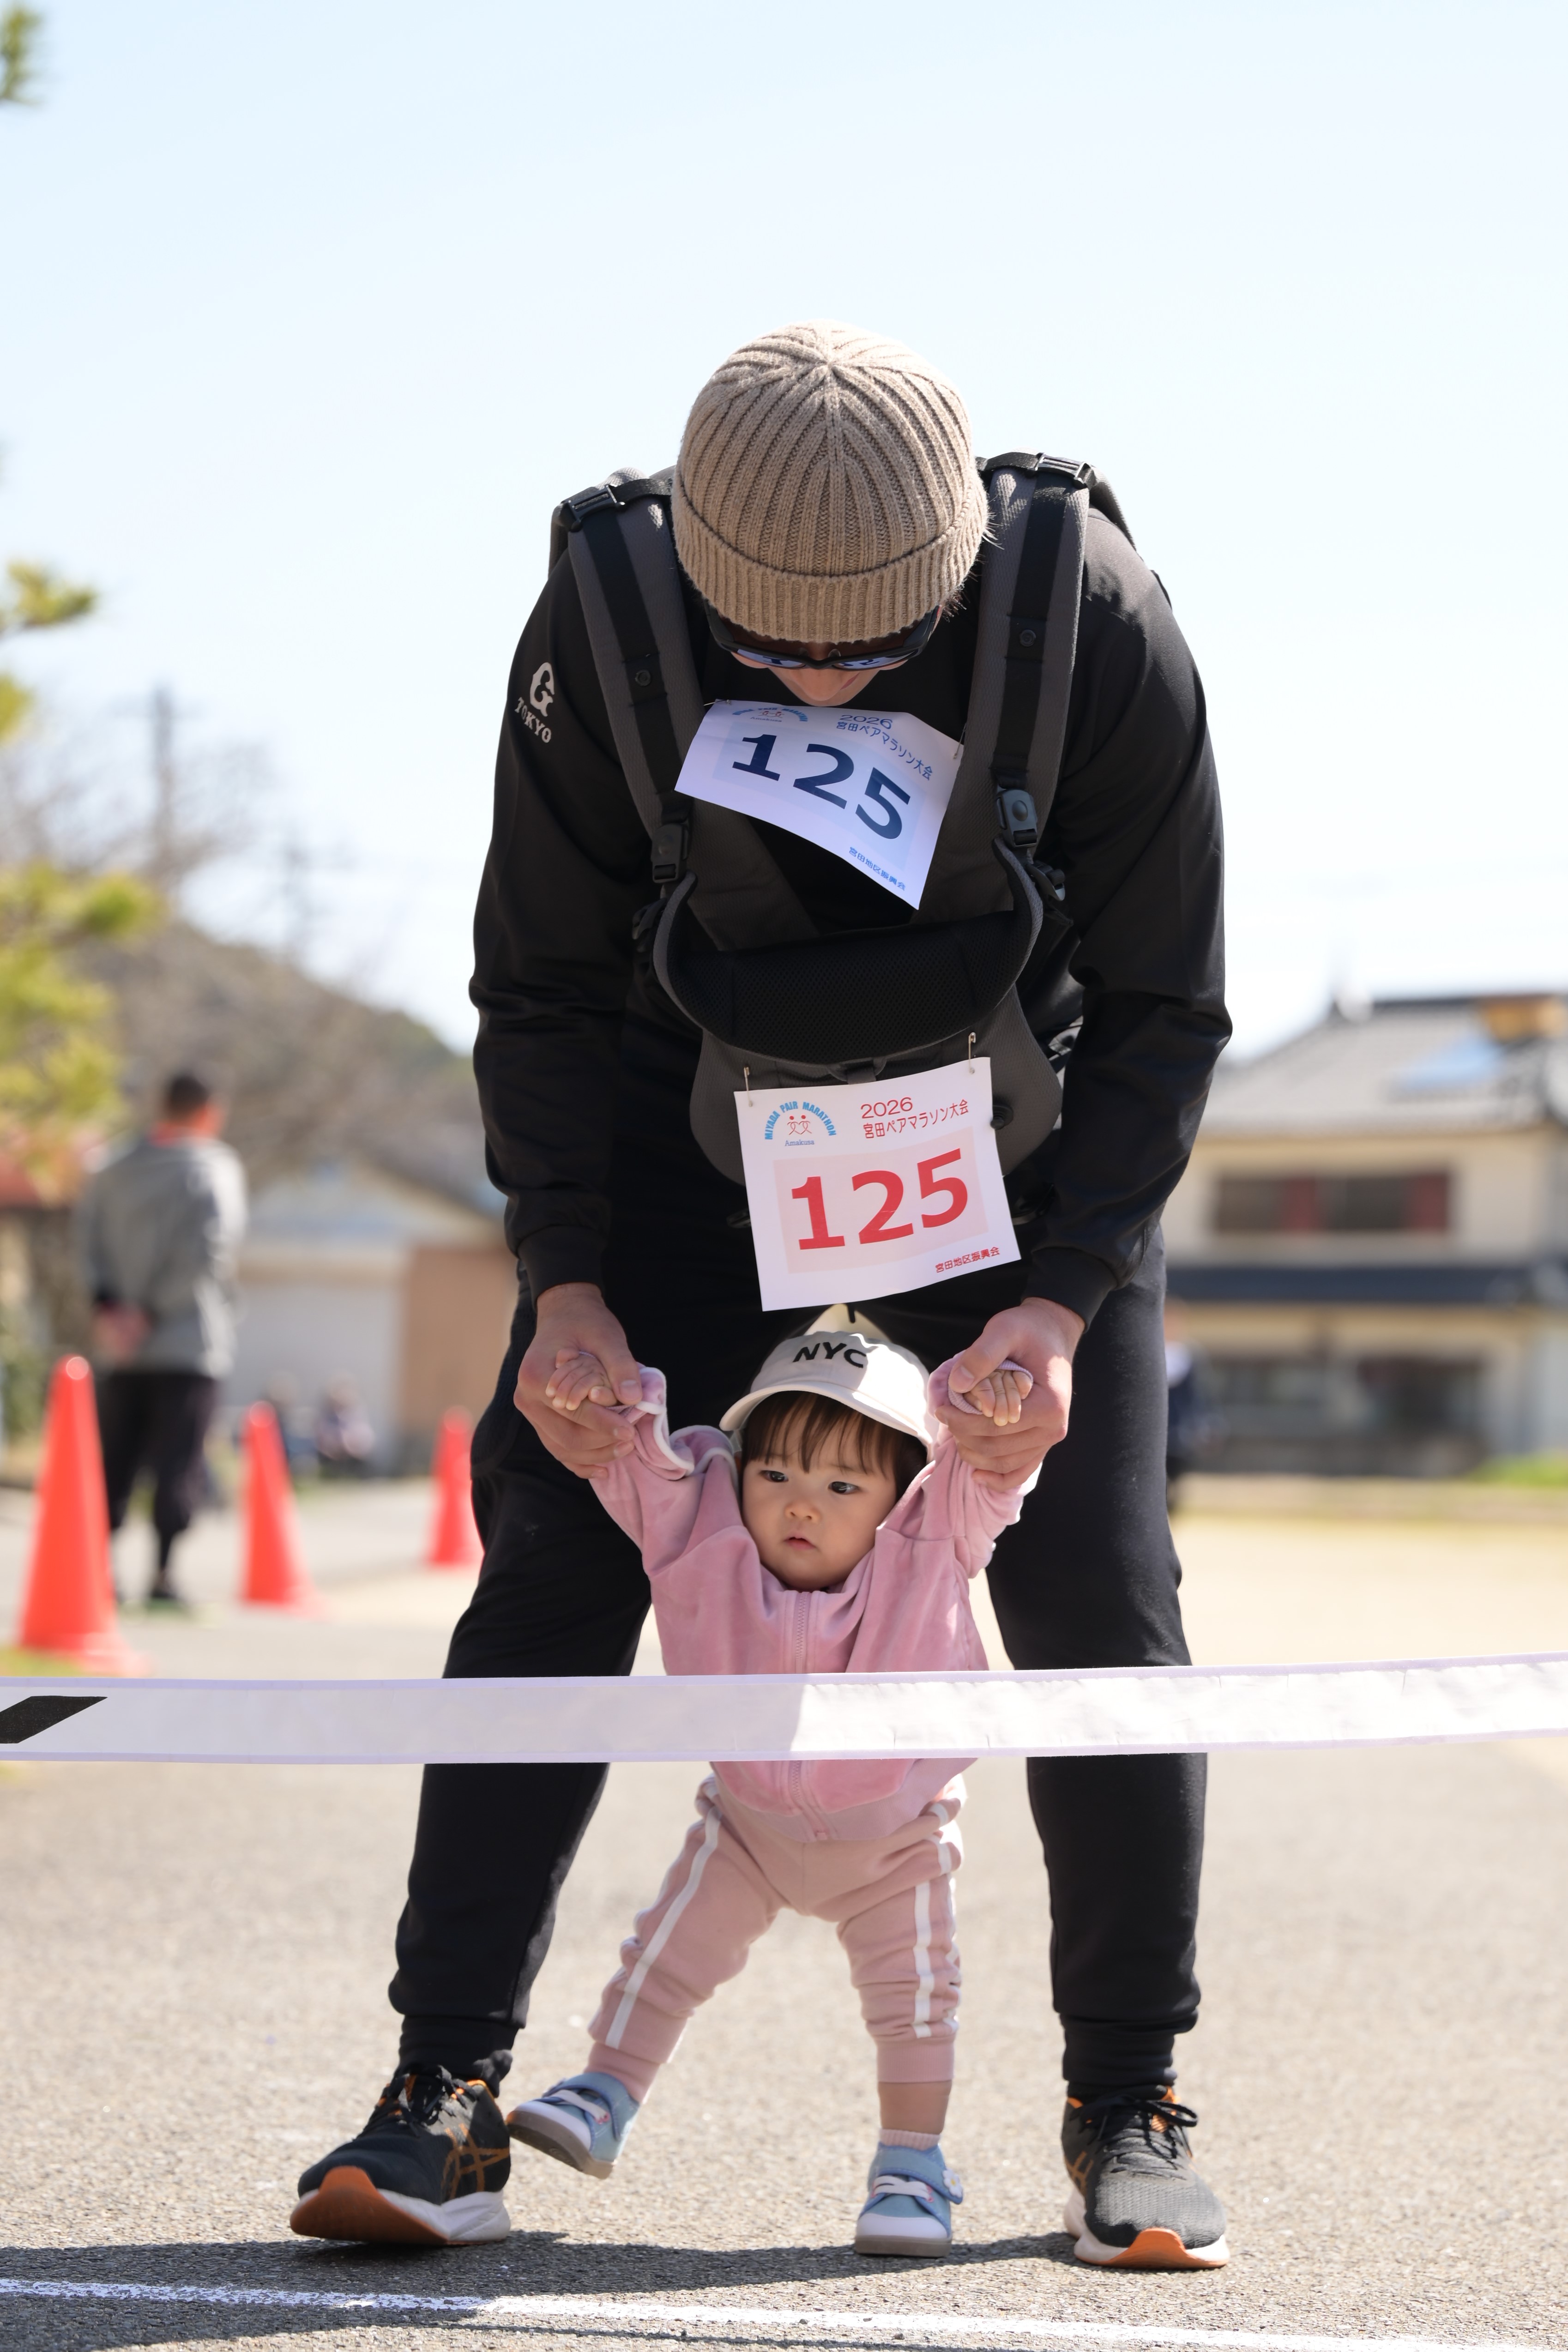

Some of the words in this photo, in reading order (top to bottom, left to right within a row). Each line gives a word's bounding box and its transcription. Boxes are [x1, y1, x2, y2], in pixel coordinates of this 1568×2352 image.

[514, 696, 552, 743] TOKYO
[839, 714, 893, 730] 2026
[836, 721, 933, 781] 宮田ペアマラソン大会
[732, 733, 911, 839] 125
[764, 1110, 781, 1140] MIYADA
[779, 1101, 798, 1113] PAIR
[802, 1101, 837, 1136] MARATHON
[860, 1097, 913, 1119] 2026
[863, 1099, 969, 1139] 宮田ペアマラソン大会
[791, 1148, 968, 1250] 125
[935, 1246, 1001, 1273] 宮田地区振興会
[792, 1341, 867, 1369] NYC
